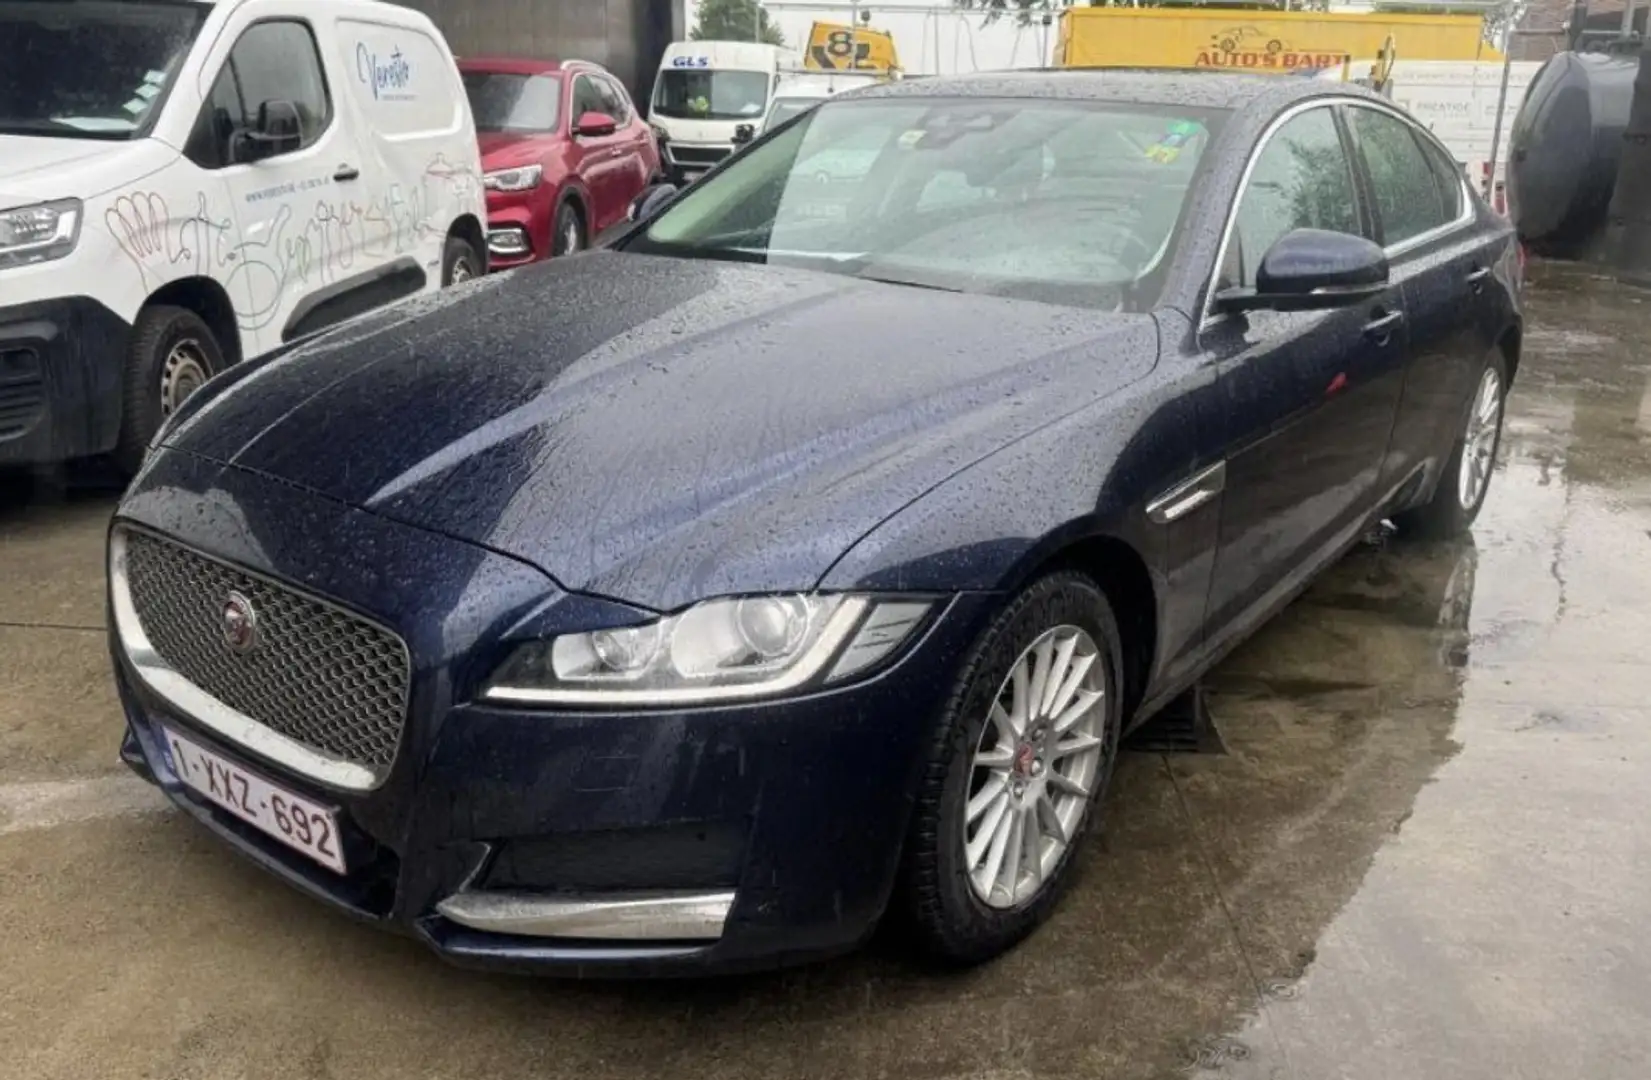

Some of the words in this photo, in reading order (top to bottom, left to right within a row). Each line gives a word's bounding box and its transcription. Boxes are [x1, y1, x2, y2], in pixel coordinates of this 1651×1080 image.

[673, 56, 708, 67] GLS
[1195, 52, 1277, 69] AUTO'S
[172, 739, 336, 857] 1-XXZ-692
